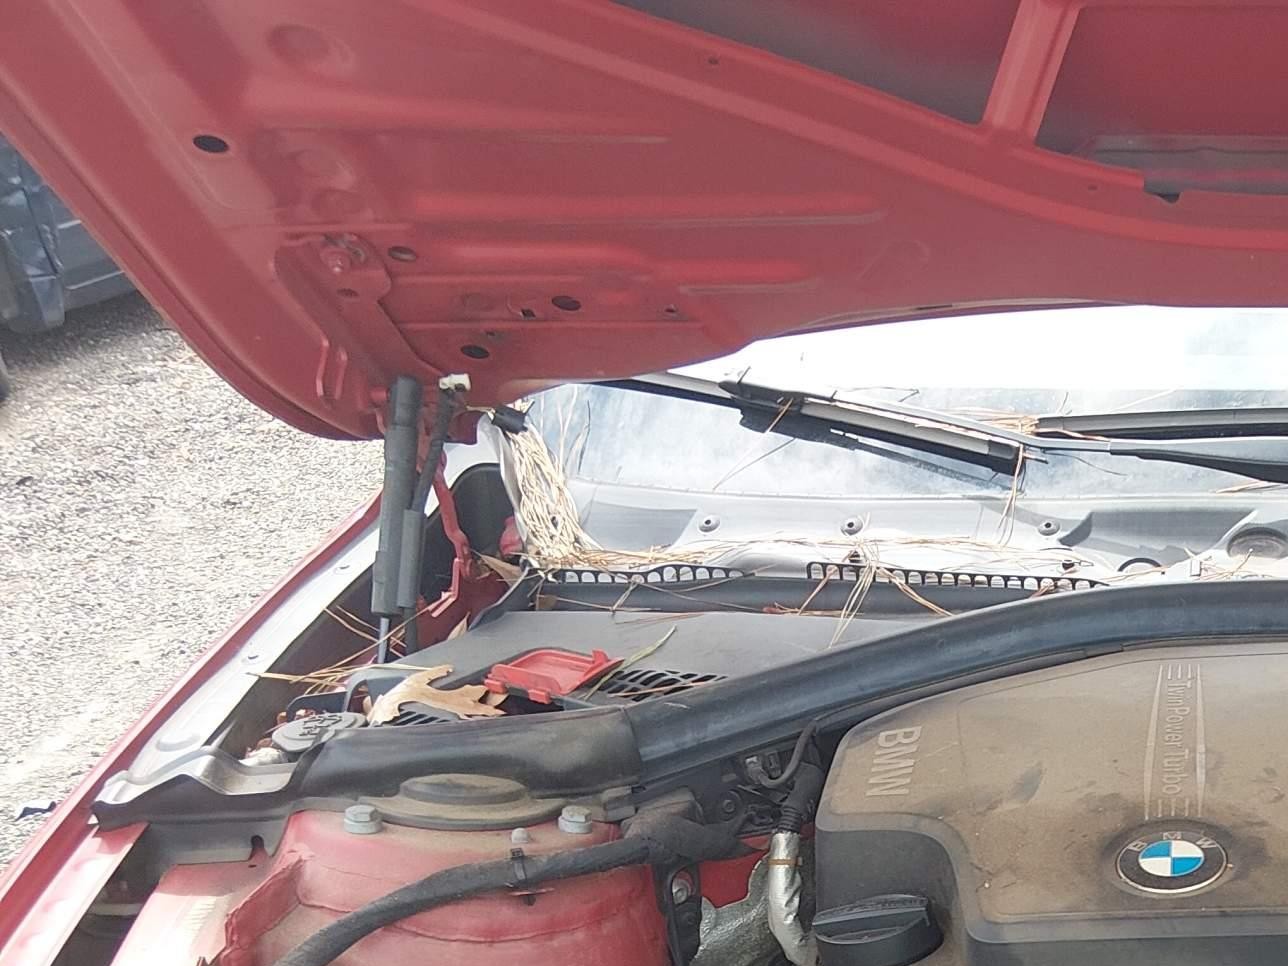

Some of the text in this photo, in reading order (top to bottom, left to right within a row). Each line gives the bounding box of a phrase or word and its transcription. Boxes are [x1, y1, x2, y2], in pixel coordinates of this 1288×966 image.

[865, 726, 922, 796] BMW
[1161, 681, 1192, 795] TwinPower Turbo
[1127, 831, 1217, 851] BMW
